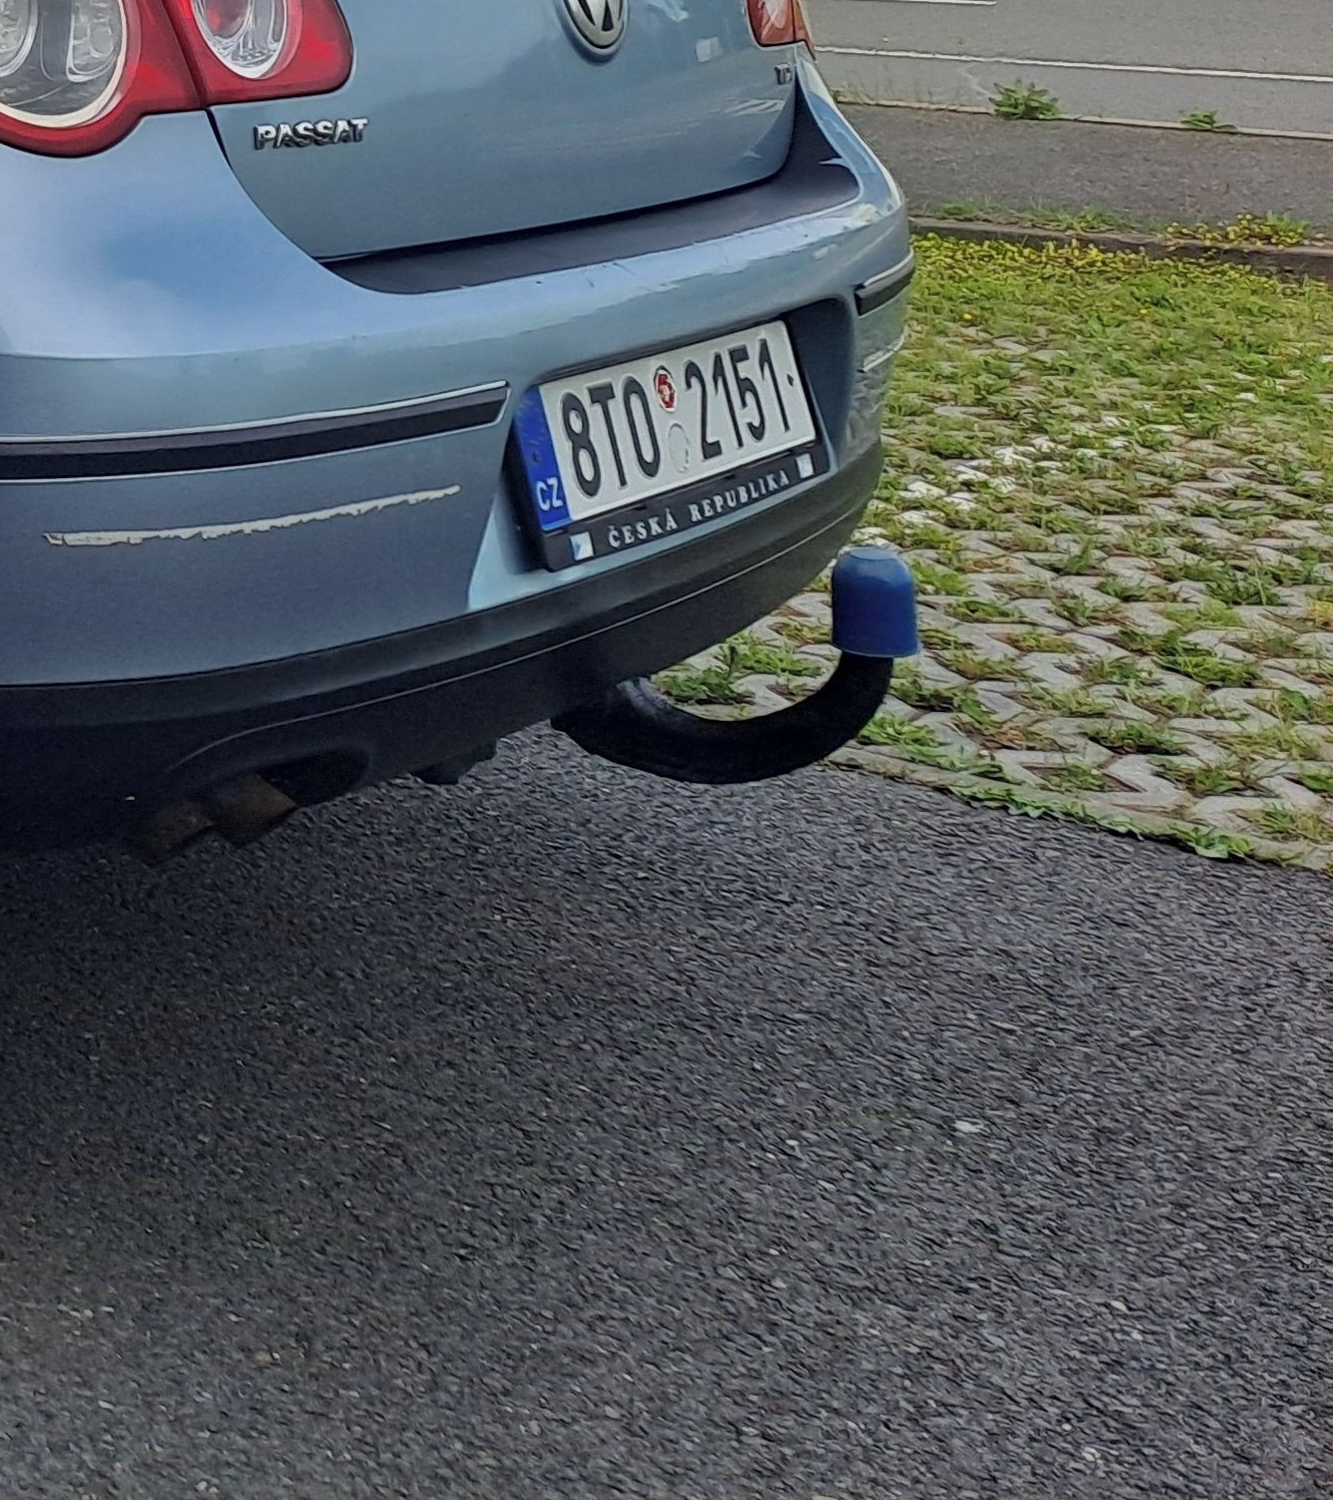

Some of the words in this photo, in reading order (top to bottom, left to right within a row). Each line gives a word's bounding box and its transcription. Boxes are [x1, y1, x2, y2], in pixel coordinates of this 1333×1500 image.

[253, 116, 370, 151] PASSAT
[684, 337, 791, 462] 2151
[536, 477, 564, 513] CZ
[607, 507, 679, 549] ČESKÁ
[688, 468, 791, 523] REPUBLIKA
